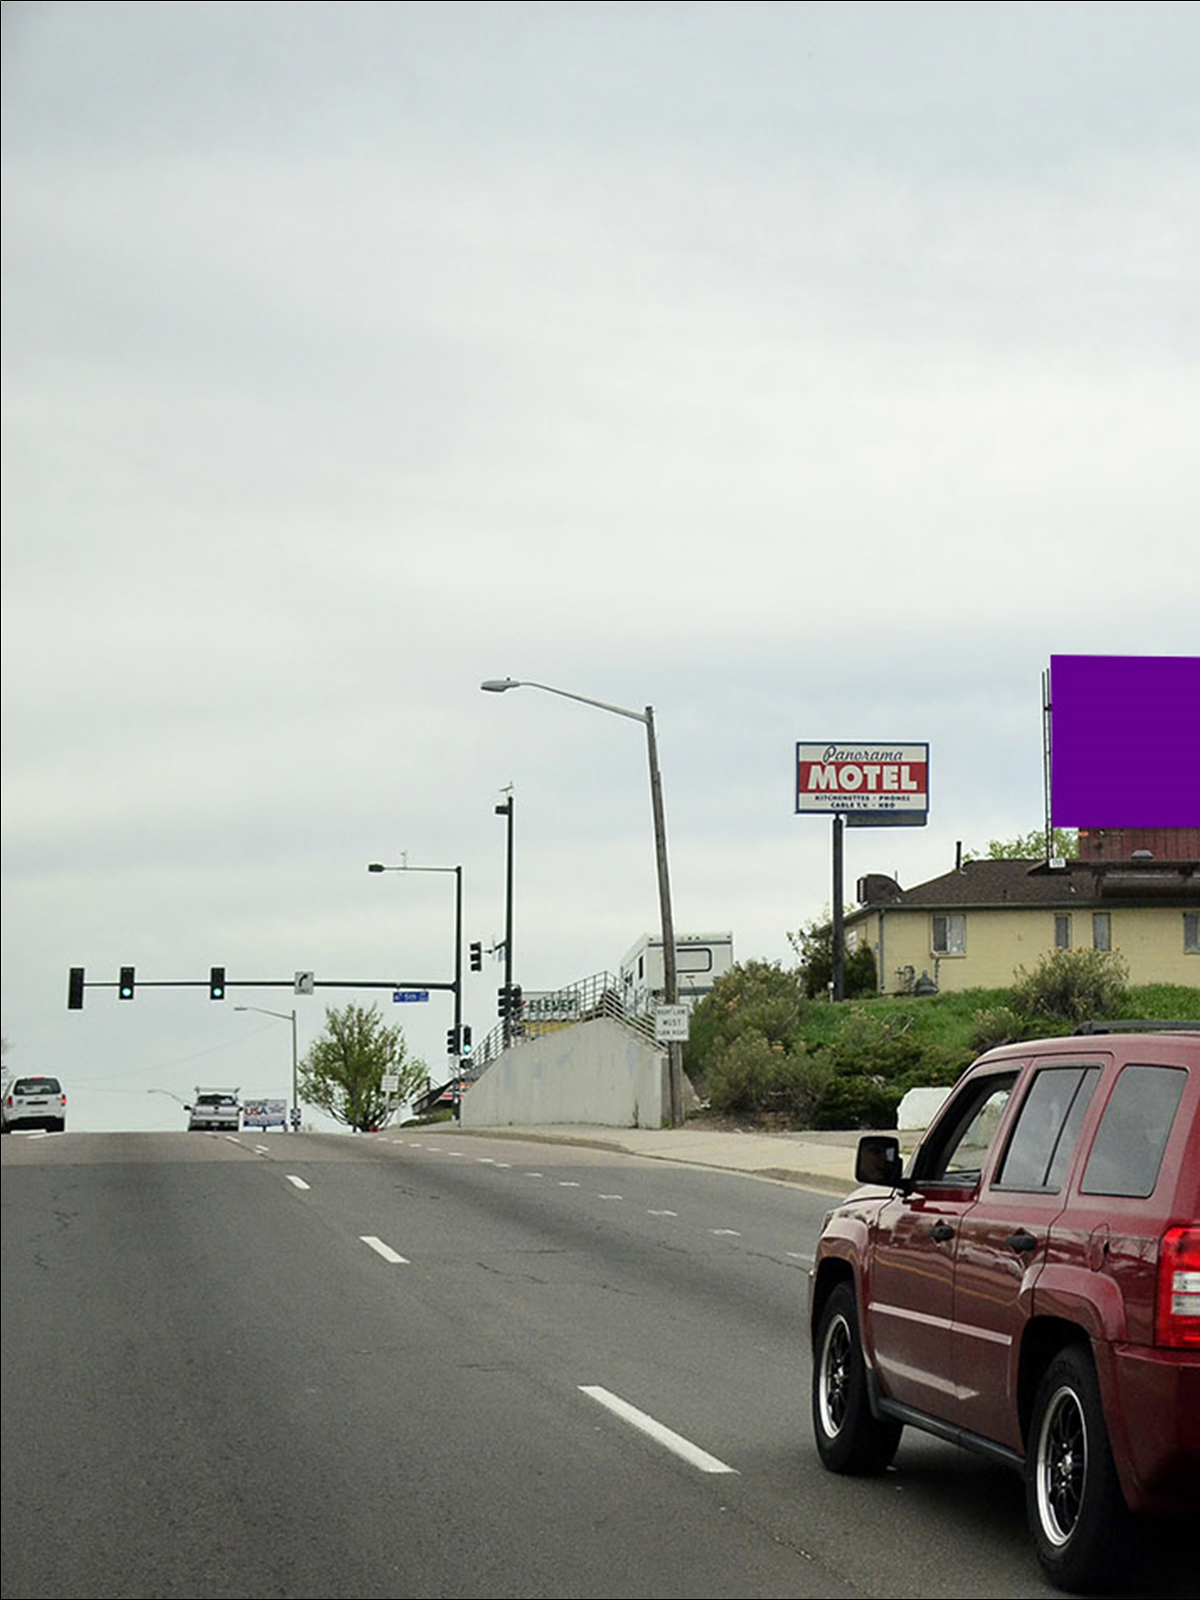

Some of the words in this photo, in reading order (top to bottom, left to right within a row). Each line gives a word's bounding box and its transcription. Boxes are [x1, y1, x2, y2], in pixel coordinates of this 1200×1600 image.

[823, 745, 903, 763] Panorama
[807, 765, 918, 791] MOTEL
[244, 1106, 269, 1117] USA
